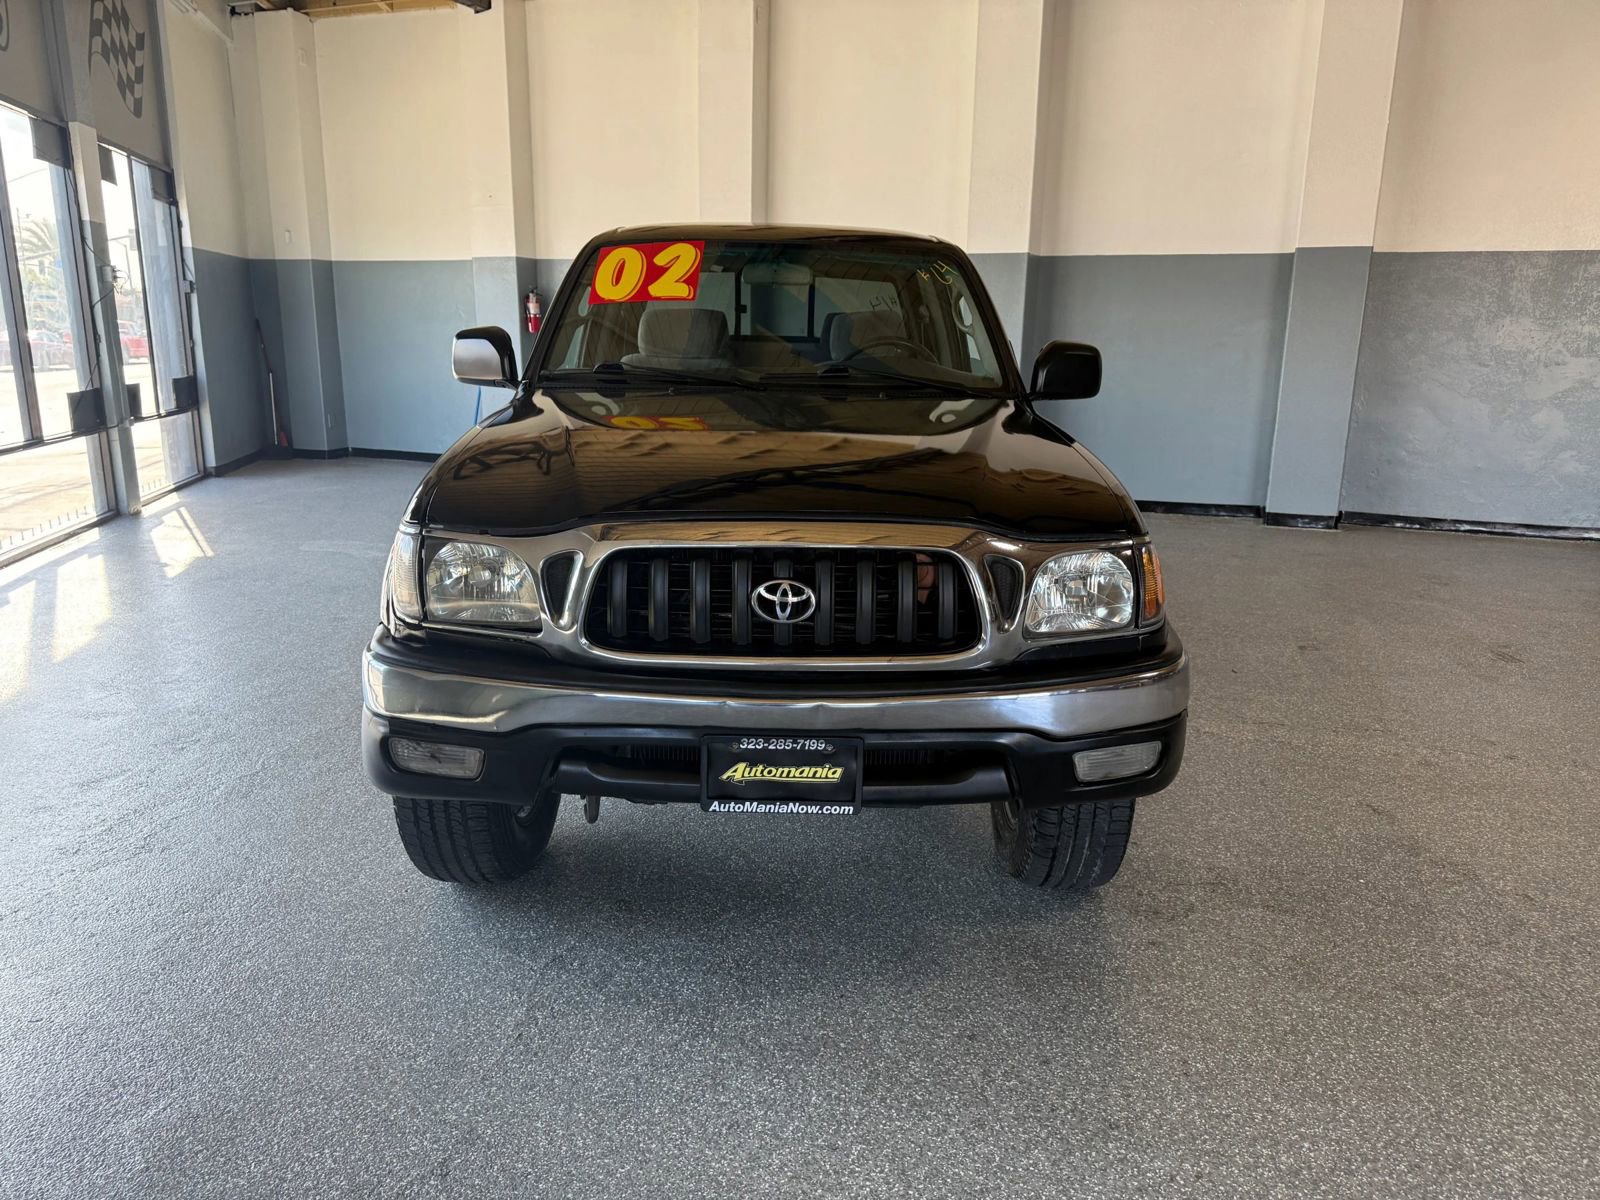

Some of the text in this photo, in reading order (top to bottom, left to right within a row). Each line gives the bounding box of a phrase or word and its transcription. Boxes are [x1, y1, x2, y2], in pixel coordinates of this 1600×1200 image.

[595, 242, 701, 302] 02
[740, 738, 826, 750] 323-285-7199
[718, 762, 845, 784] Automania
[709, 801, 854, 815] AutoManiaNow.com
